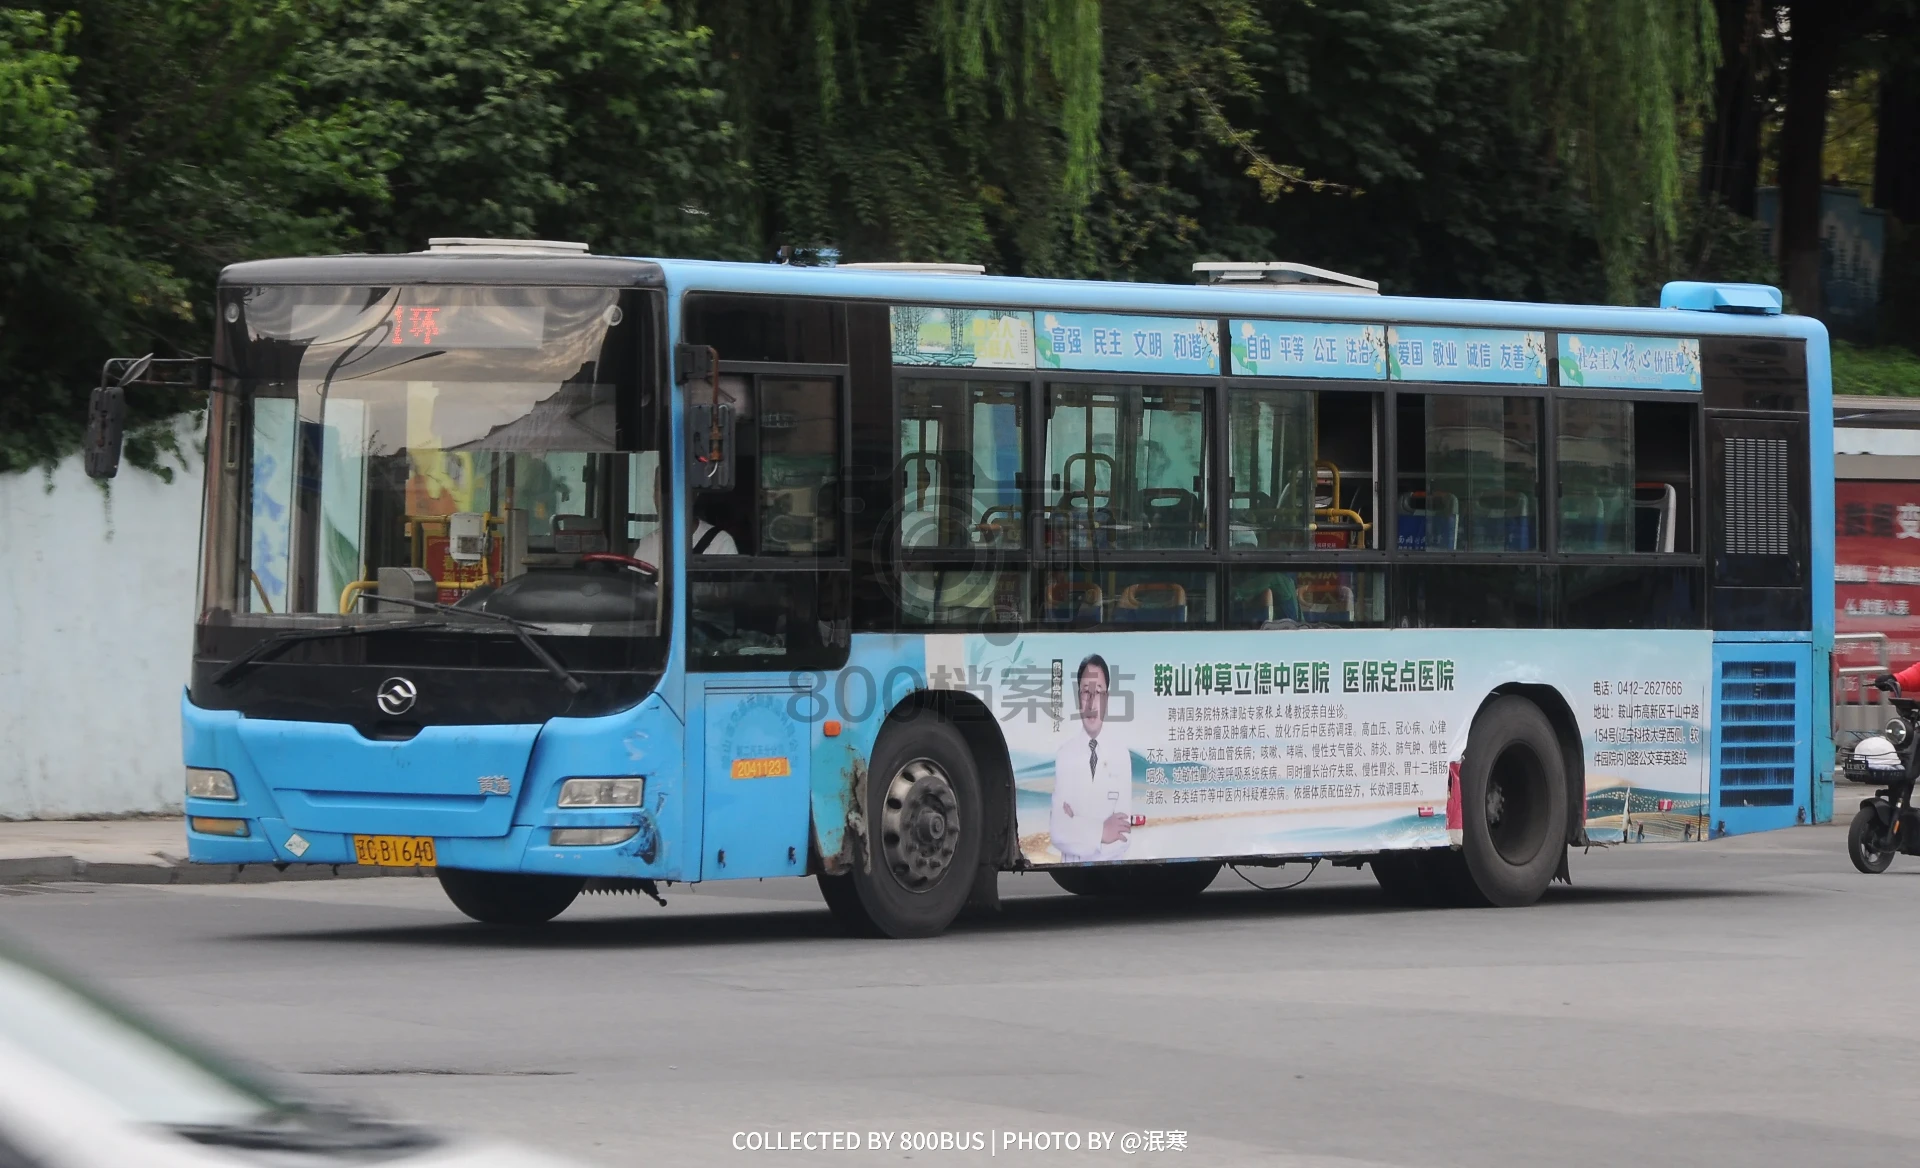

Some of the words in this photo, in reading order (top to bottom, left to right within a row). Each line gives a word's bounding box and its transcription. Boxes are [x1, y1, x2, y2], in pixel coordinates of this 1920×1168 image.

[1051, 327, 1082, 355] 富强
[1093, 329, 1123, 356] 民主
[1133, 332, 1162, 358] 文明
[1173, 332, 1202, 359] 和谐
[1247, 335, 1271, 360] 自由
[1280, 336, 1304, 362] 平等
[1313, 337, 1337, 363] 公正
[1346, 338, 1369, 364] 法治
[1398, 341, 1423, 366] 爱国
[1432, 341, 1458, 367] 敬业
[1467, 342, 1491, 368] 诚信
[1500, 344, 1525, 369] 友善
[1578, 342, 1685, 374] 社会主义核心价值观
[1154, 661, 1330, 697] 鞍山神草立德中医院
[1343, 660, 1454, 693] 医保定点医院
[737, 760, 781, 777] 2041123
